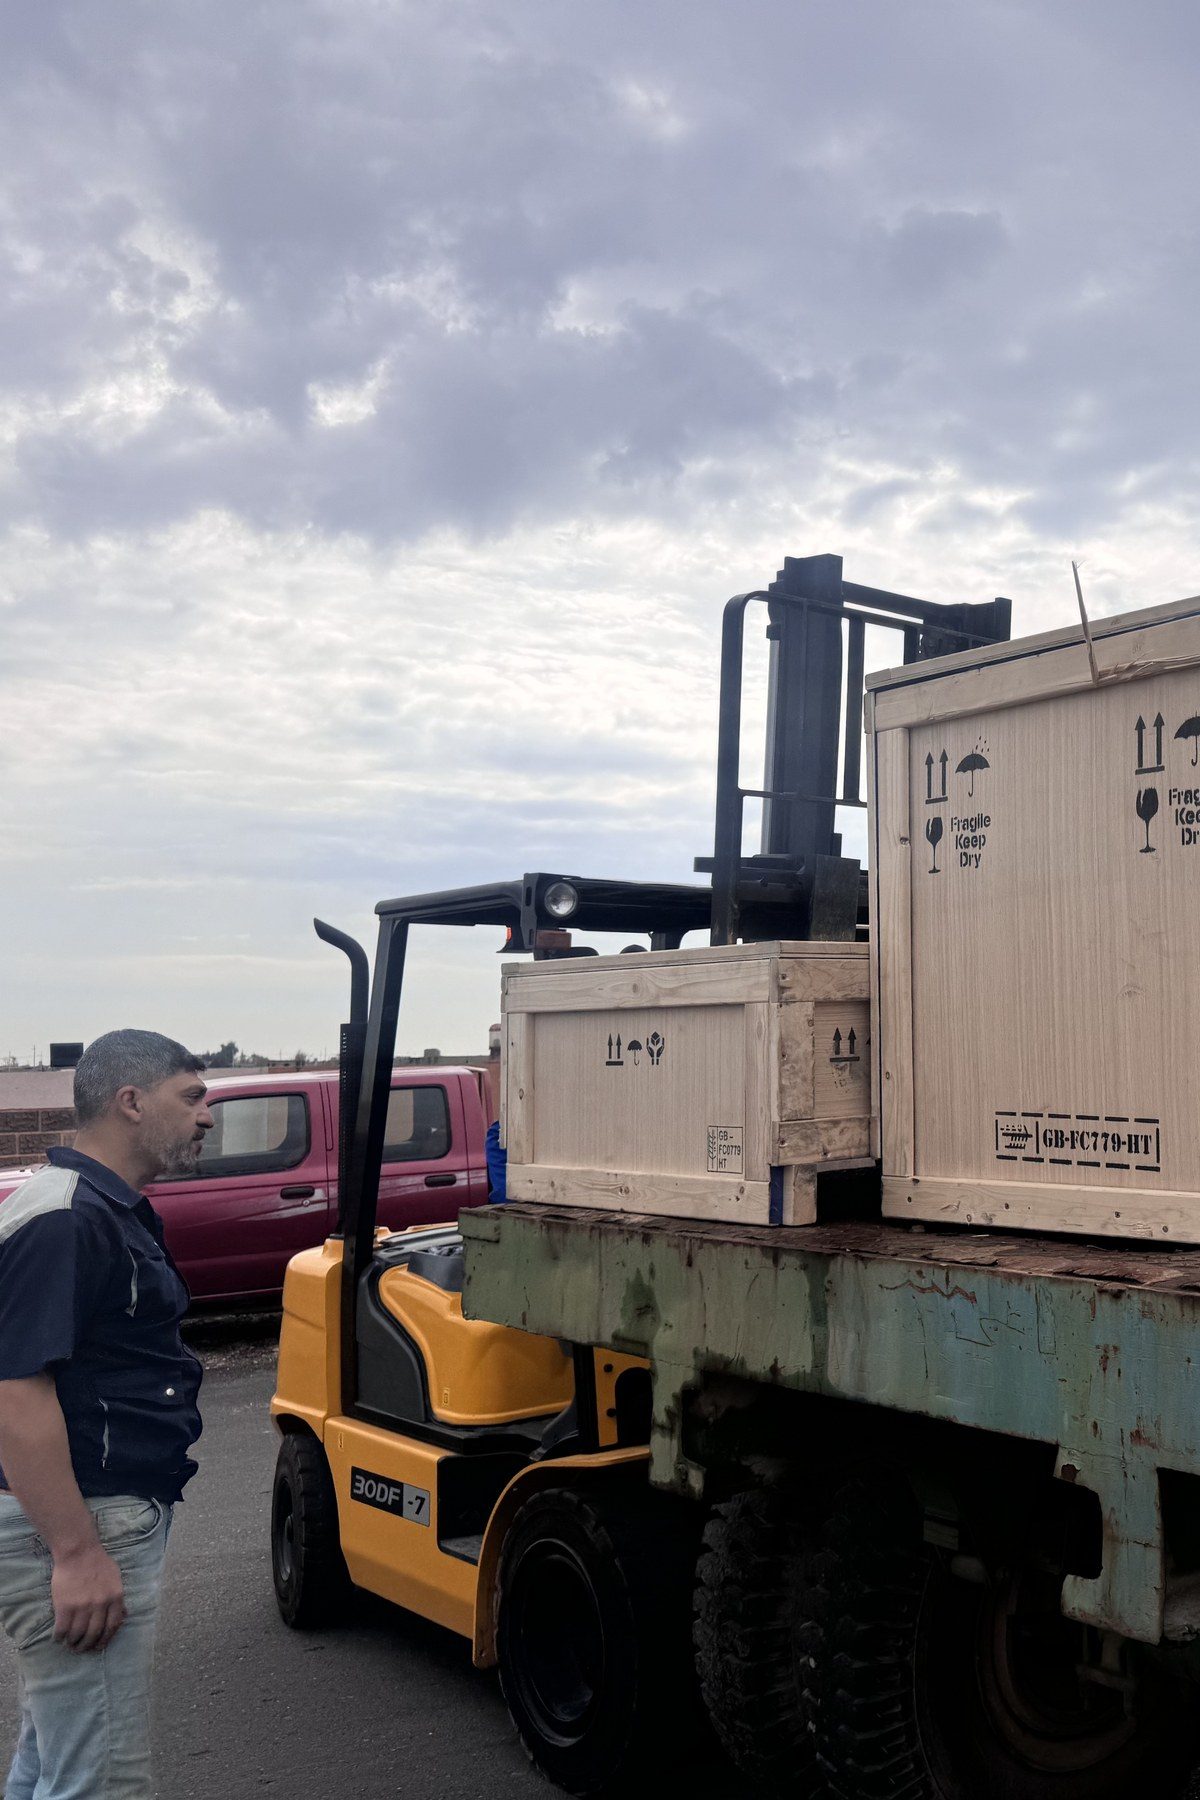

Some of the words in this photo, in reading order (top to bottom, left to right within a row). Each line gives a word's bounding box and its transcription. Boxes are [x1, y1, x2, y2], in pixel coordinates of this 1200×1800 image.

[950, 813, 991, 833] Fragile
[955, 834, 987, 850] Keep
[960, 851, 982, 869] Dry
[718, 1144, 742, 1156] FC0779
[1042, 1128, 1152, 1155] GB-FC779-HT
[718, 1158, 727, 1169] HT
